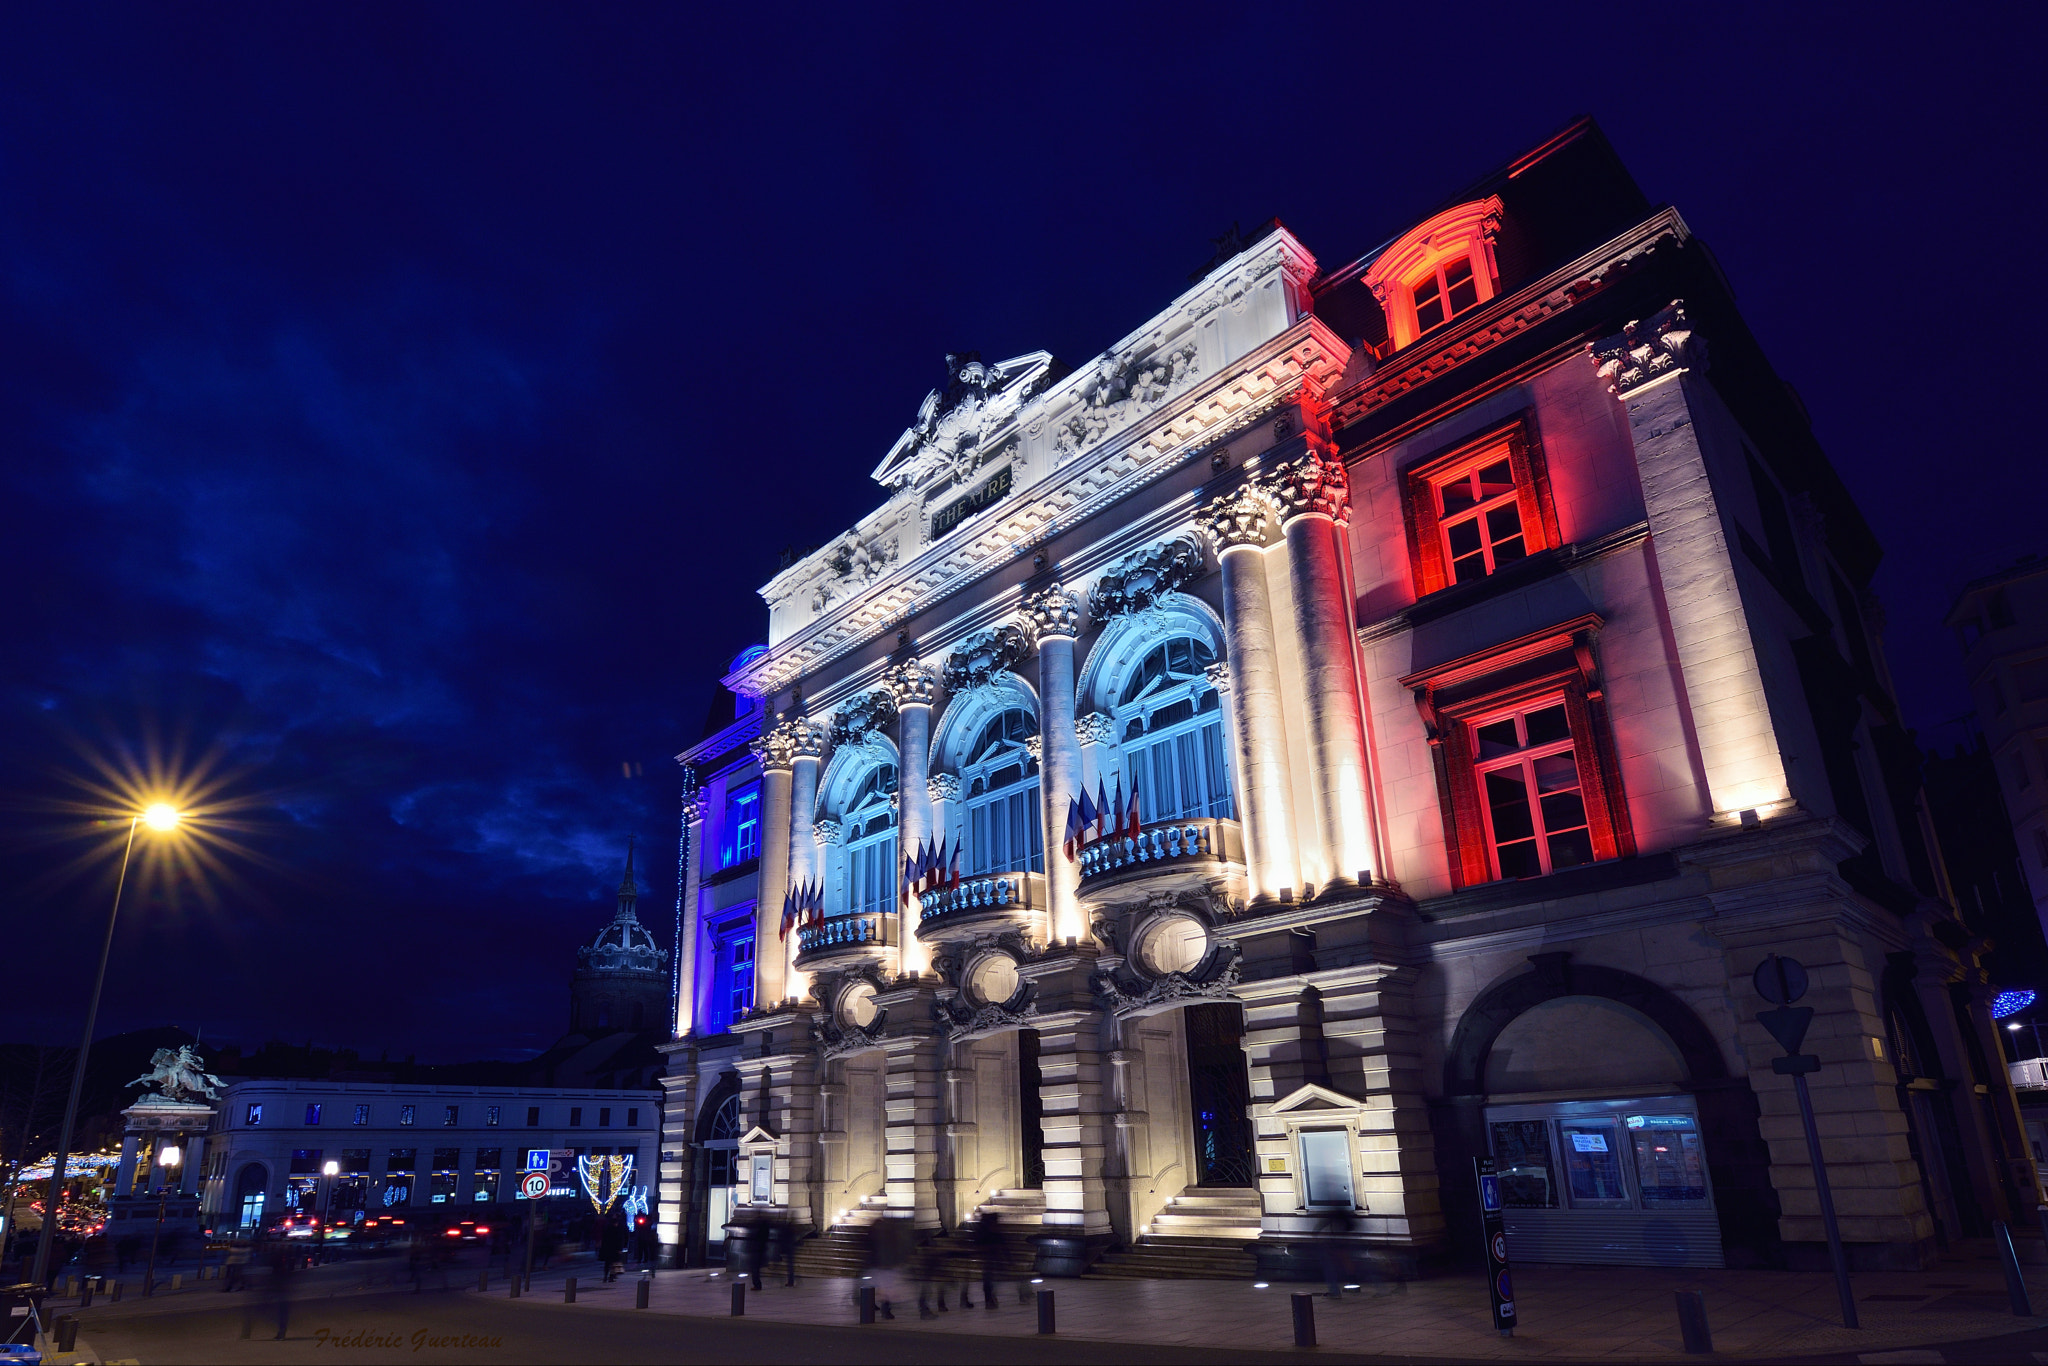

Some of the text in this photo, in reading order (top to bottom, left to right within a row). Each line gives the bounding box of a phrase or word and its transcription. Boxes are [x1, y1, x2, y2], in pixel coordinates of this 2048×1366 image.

[529, 1180, 544, 1192] 10
[546, 1188, 570, 1196] UVERT
[1496, 1241, 1505, 1254] 10
